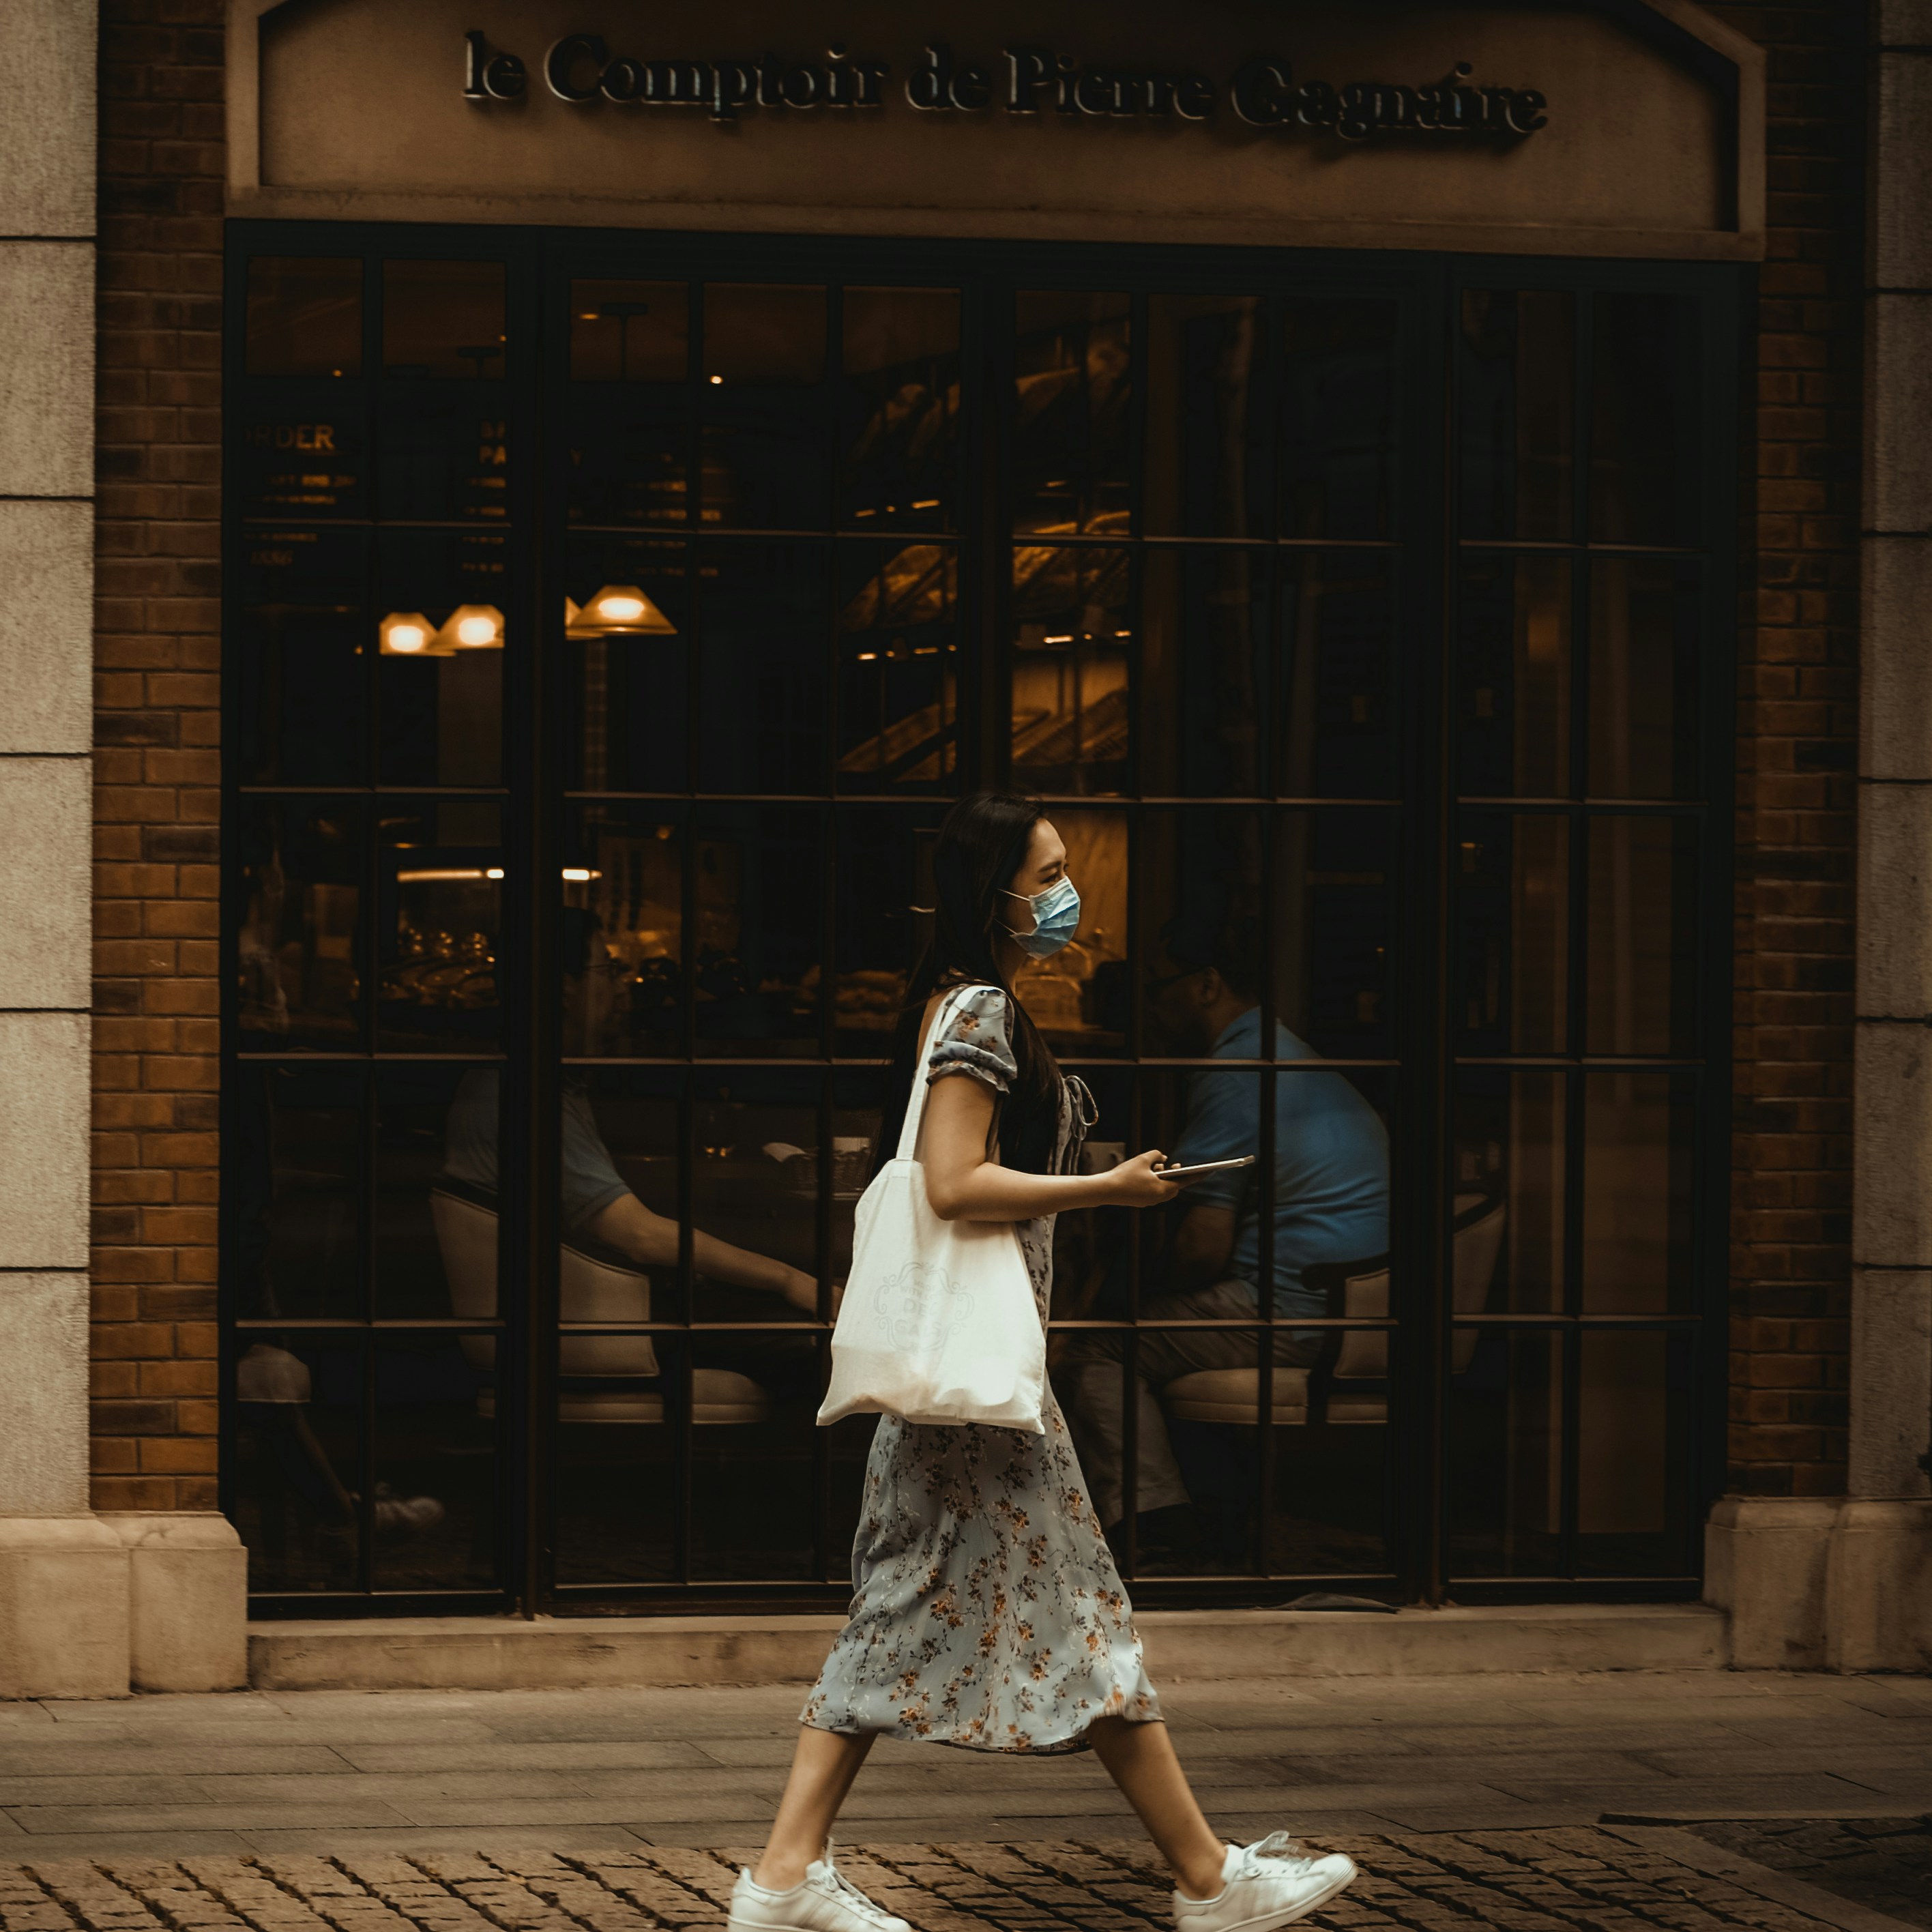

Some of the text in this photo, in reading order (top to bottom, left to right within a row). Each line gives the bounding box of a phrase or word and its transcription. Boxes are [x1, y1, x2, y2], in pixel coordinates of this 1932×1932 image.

[463, 30, 1548, 140] le Comptoir de Pierre Gagnaire
